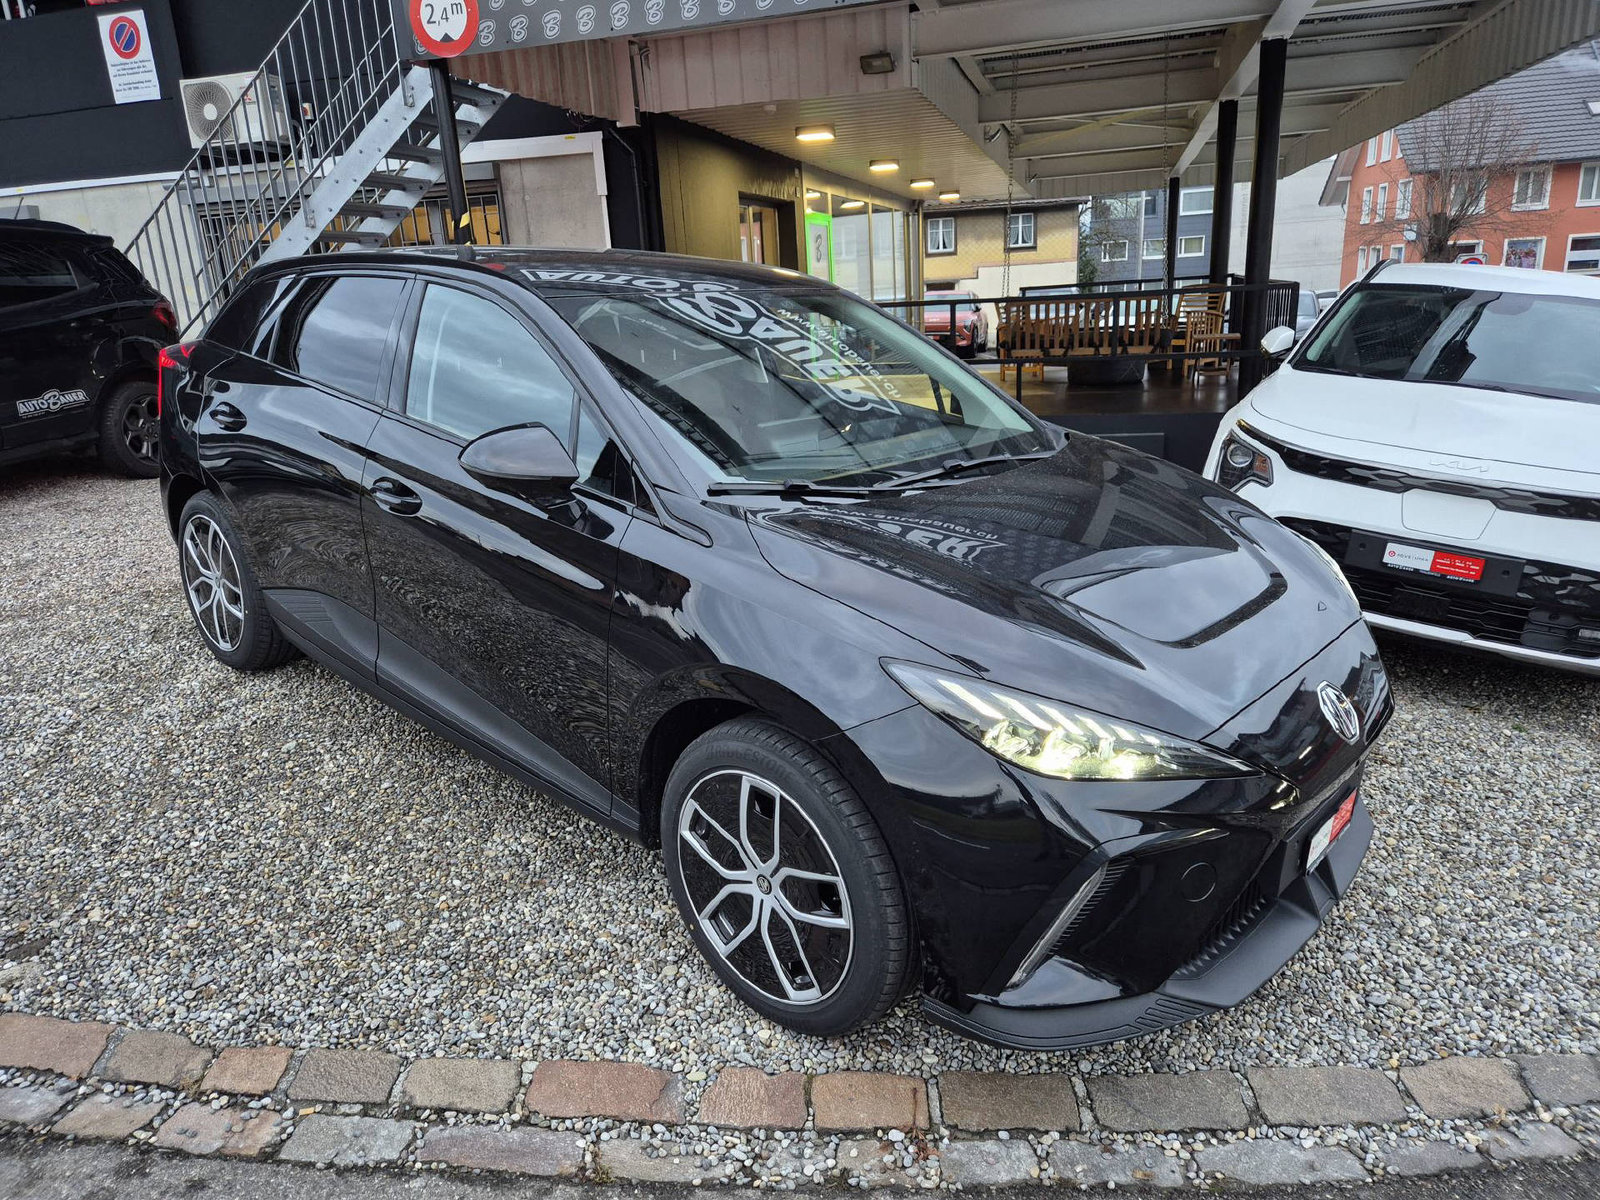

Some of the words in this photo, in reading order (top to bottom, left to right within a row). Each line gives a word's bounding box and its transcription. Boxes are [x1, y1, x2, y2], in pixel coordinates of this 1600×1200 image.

[509, 15, 528, 42] B
[542, 10, 561, 39] B
[576, 5, 596, 34] B
[610, 0, 630, 30] B
